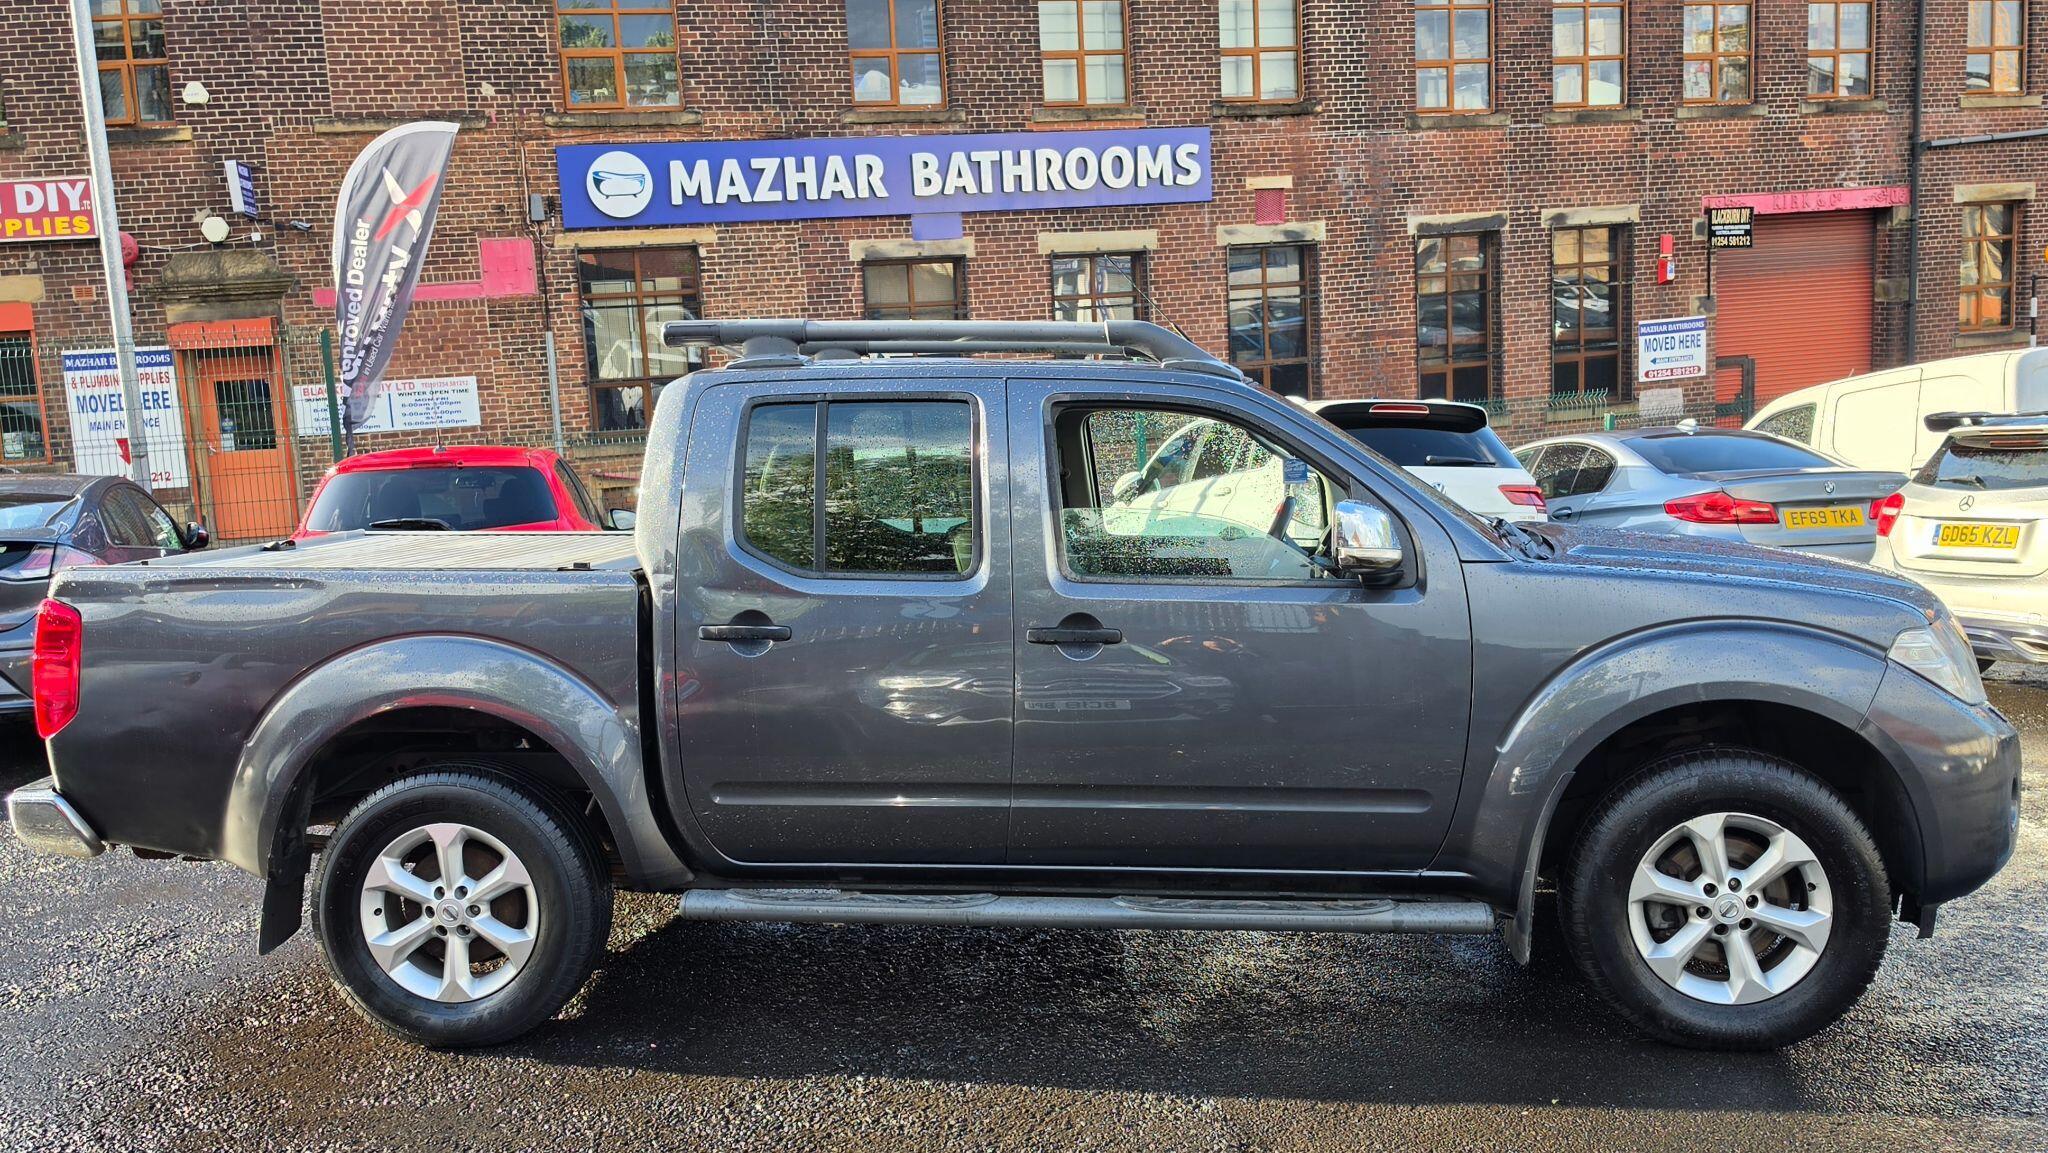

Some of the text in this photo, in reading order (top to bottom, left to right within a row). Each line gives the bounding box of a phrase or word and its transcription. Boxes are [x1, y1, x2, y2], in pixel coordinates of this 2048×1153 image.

[669, 144, 1203, 206] MAZHAR BATHROOMS
[14, 181, 86, 213] DIY
[1640, 321, 1705, 334] MAZHAR BATHROOMS
[365, 347, 379, 368] Used
[373, 332, 384, 347] Car
[1644, 333, 1702, 353] MOVED HERE
[65, 354, 171, 368] MAZHAR BROOMS
[71, 371, 170, 389] & PLUMBIN PPLIES
[1648, 366, 1699, 378] 01254 581212
[395, 381, 416, 392] LTD
[141, 391, 171, 411] ERE
[89, 420, 111, 432] MAIN
[151, 471, 172, 482] 212
[1790, 508, 1859, 526] EF69 TKA
[1941, 526, 1979, 543] GD65
[1981, 526, 2013, 545] KZL
